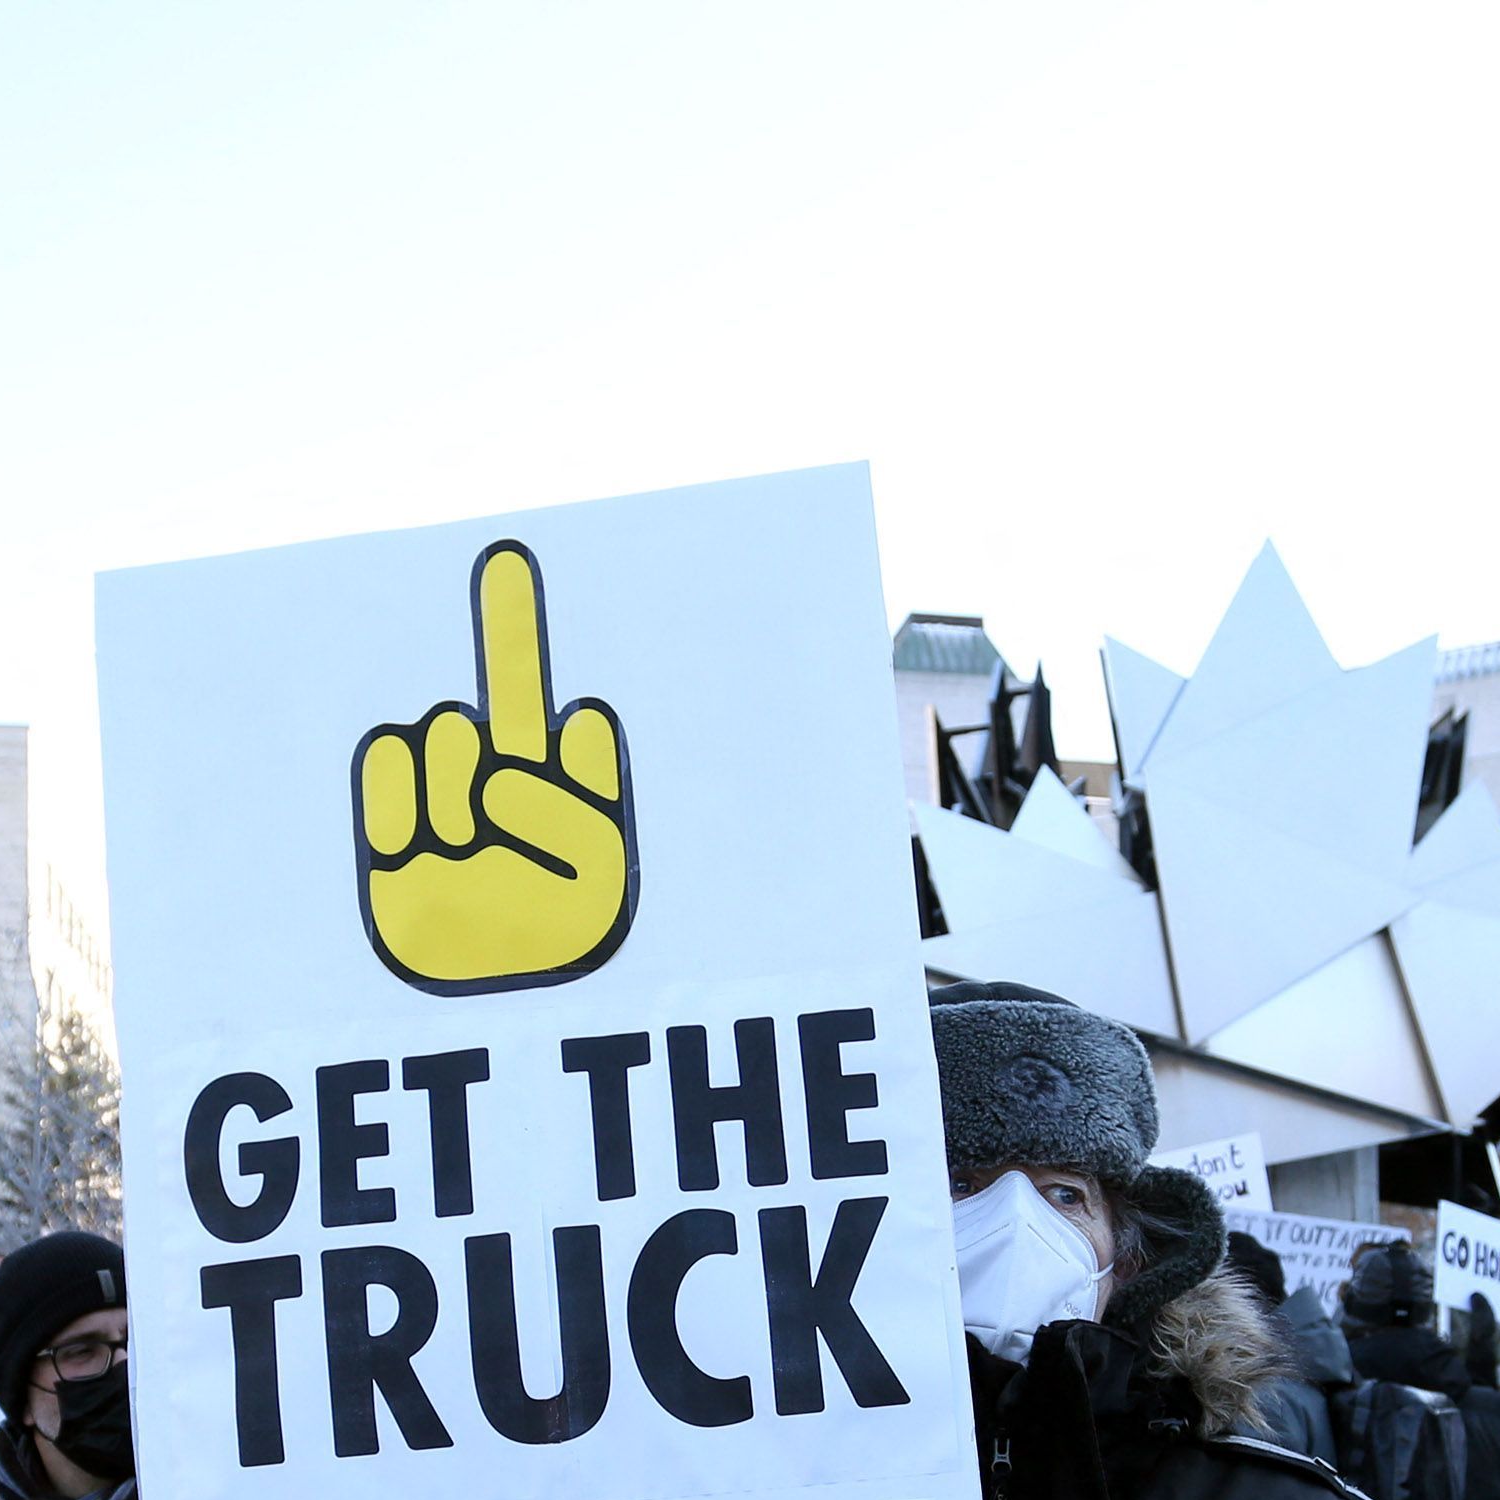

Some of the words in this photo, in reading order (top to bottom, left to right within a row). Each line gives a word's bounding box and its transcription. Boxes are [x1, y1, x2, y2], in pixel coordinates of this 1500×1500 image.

[182, 1046, 491, 1244] GET
[560, 1006, 890, 1203] THE
[199, 1195, 912, 1469] TRUCK
[1442, 1230, 1469, 1269] GO
